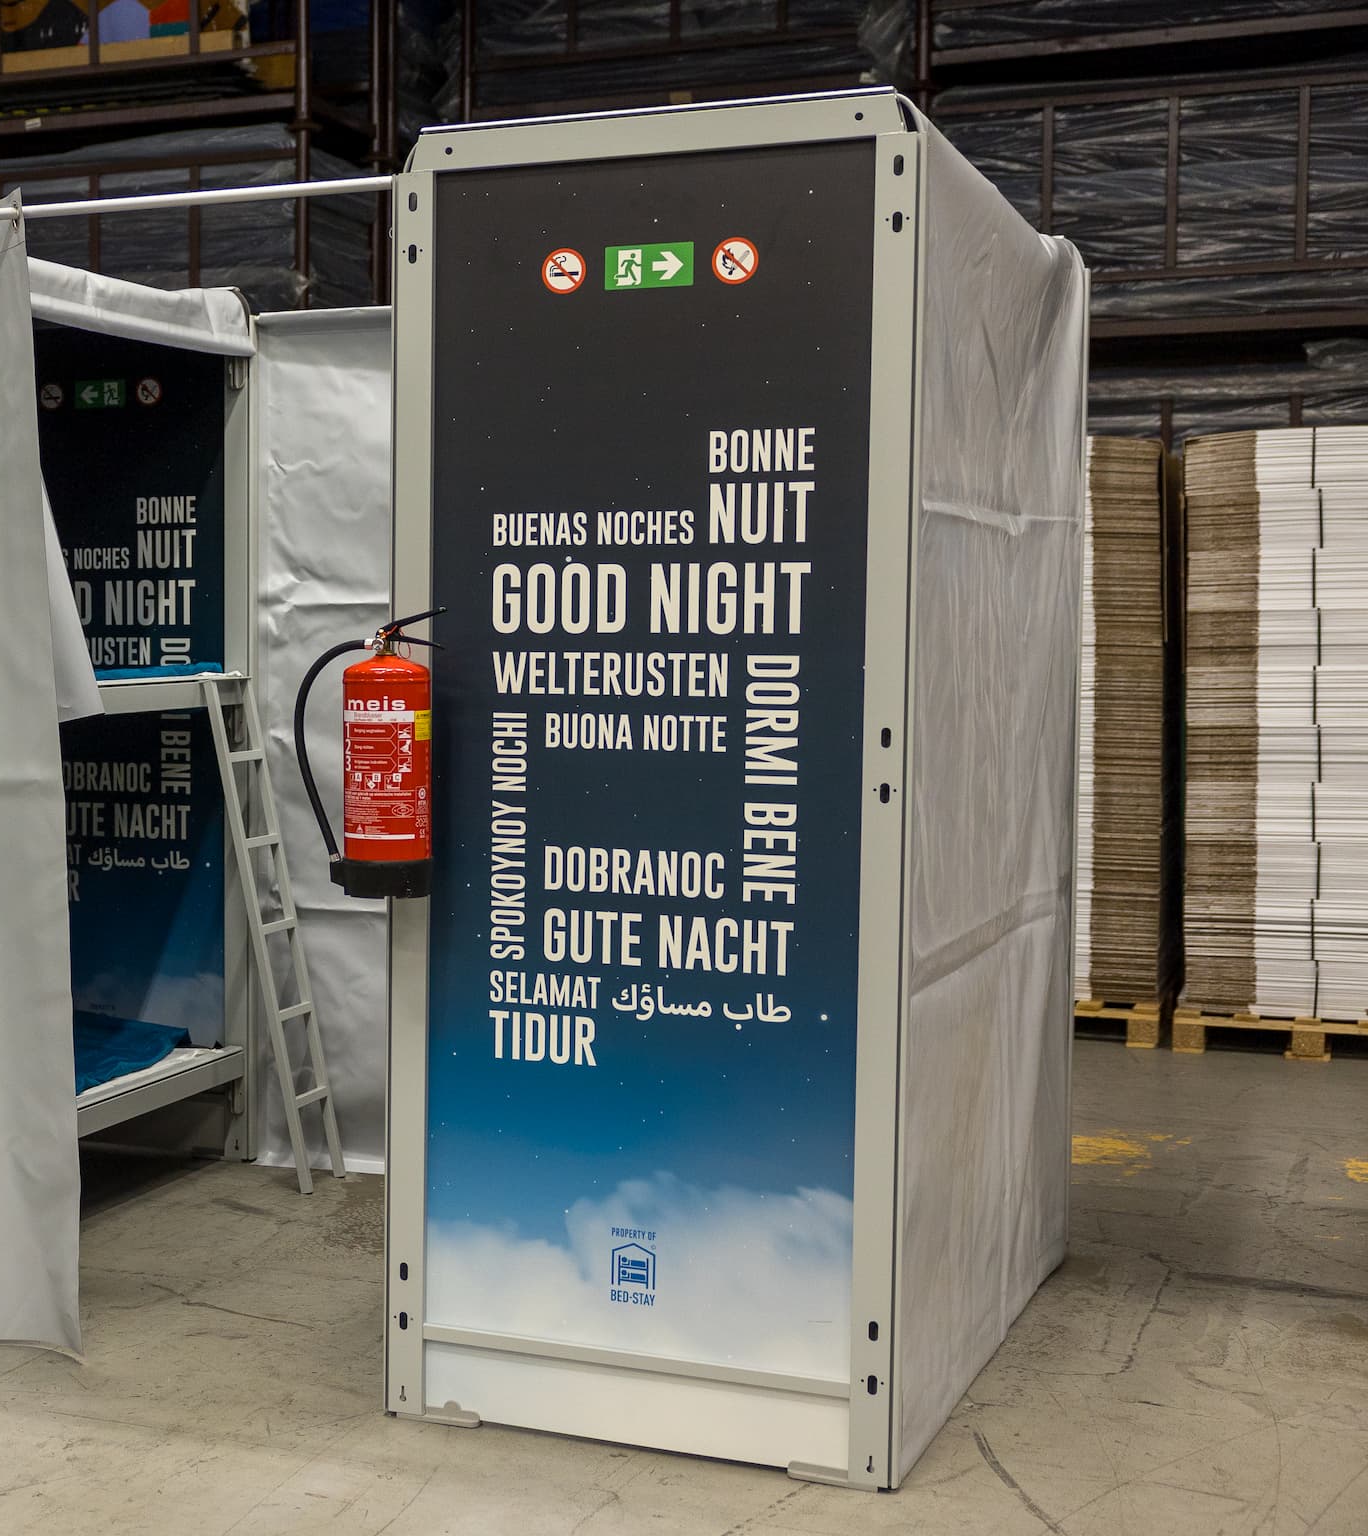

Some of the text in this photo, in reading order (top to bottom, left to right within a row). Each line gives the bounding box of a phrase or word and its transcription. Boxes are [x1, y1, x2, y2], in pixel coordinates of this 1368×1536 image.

[709, 427, 816, 473] BONNE
[136, 496, 196, 525] BONNE
[493, 510, 695, 546] BUENAS NOCHES
[709, 481, 815, 544] NUIT
[73, 547, 130, 570] NOCHES
[137, 529, 197, 569] NUIT
[104, 579, 196, 625] NIGHT
[492, 561, 812, 635] GOOD NIGHT
[492, 651, 728, 697] WELTERUSTEN
[347, 696, 406, 711] meis
[345, 722, 350, 738] 1
[345, 739, 351, 755] 2
[545, 712, 727, 752] BUONA NOTTE
[63, 761, 151, 792] OBRANOC
[160, 730, 191, 796] BENE
[345, 755, 351, 771] 3
[742, 655, 800, 904] DORMI BENE
[66, 801, 191, 841] UTE NACHT
[489, 712, 528, 961] SPOKOYNOY NOCHI
[544, 845, 725, 899] DOBRANOC
[543, 908, 794, 977] GUTE NACHT
[489, 970, 601, 1009] SELAMAT
[489, 1010, 597, 1066] TIDUR
[611, 1227, 656, 1241] PROPERTY OF
[610, 1289, 656, 1306] BED-STAY
